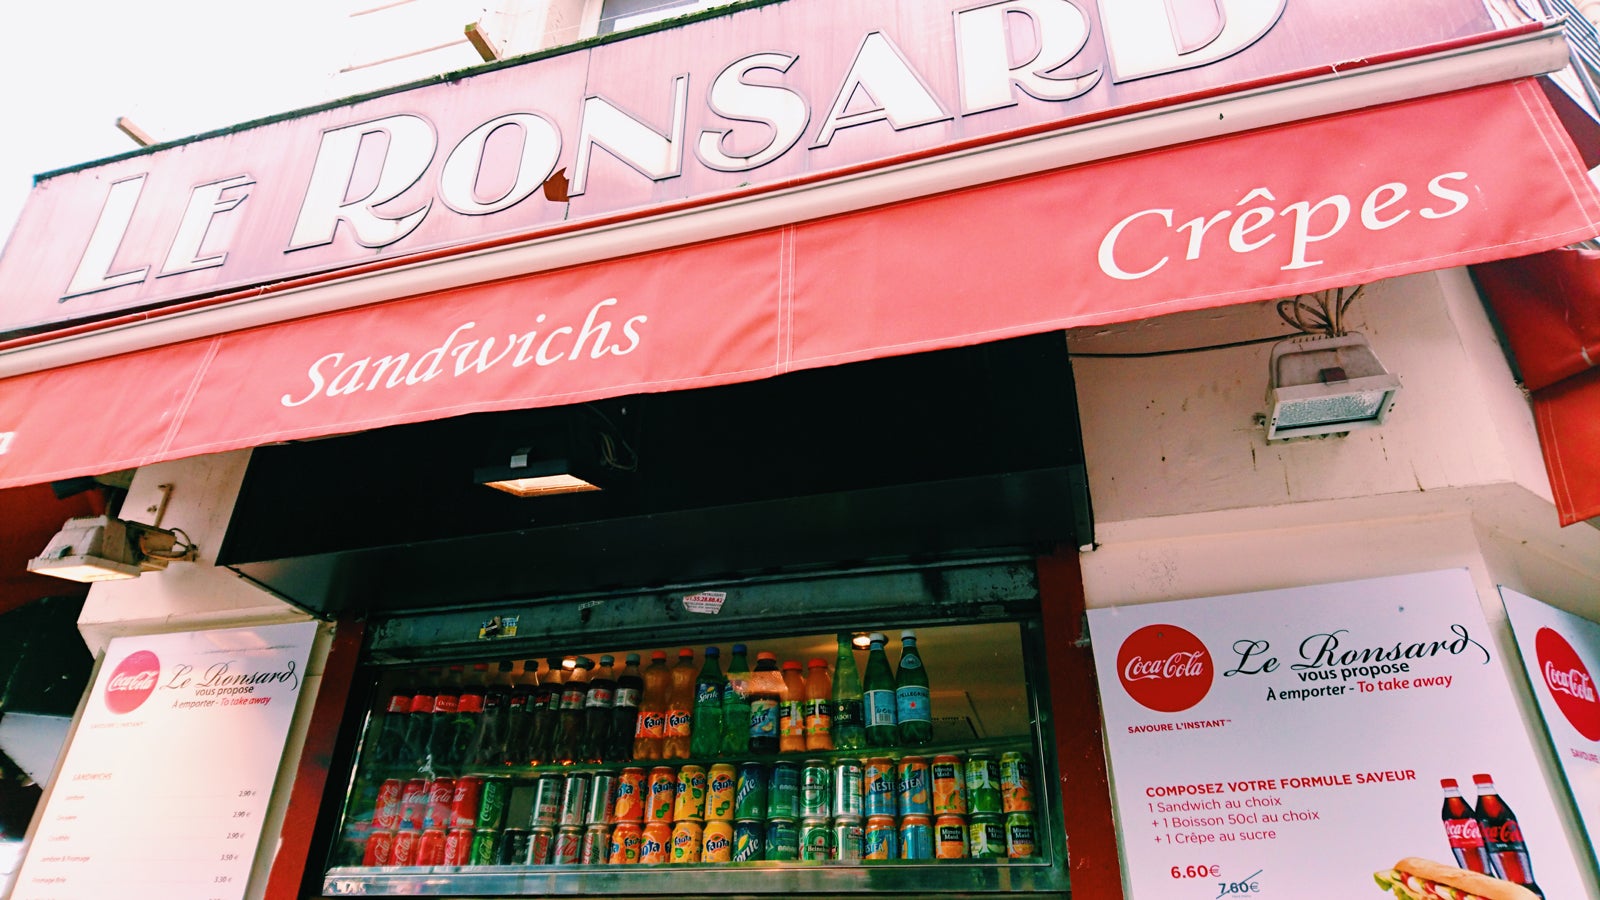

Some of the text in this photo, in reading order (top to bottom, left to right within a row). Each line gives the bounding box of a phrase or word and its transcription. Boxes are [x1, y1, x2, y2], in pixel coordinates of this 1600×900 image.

[59, 0, 1286, 303] LE RONSARD
[1097, 171, 1470, 280] Crêpes
[281, 297, 648, 408] Sandwichs
[1223, 623, 1491, 678] Le Ronsard
[159, 660, 299, 692] Le Ronsard
[1124, 651, 1205, 682] Coca-Cola
[1298, 661, 1410, 682] vous propose
[107, 671, 159, 692] Coca-Cola
[195, 686, 254, 701] vous propose
[1266, 687, 1277, 702] À
[1279, 684, 1346, 701] emporter
[1357, 680, 1375, 693] To
[1378, 678, 1410, 692] take
[1413, 675, 1453, 689] away
[1545, 660, 1596, 703] Coca-Cola
[179, 698, 215, 710] emporter
[220, 698, 230, 707] To
[230, 697, 247, 707] take
[248, 696, 272, 707] away
[1128, 722, 1174, 734] SAVOURE
[1146, 769, 1417, 798] COMPOSEZ VOTRE FORMULE SAVEUR
[1148, 795, 1282, 813] 1 Sandwich au choix
[1151, 809, 1320, 829] + 1 Boisson 50cl au choix
[1154, 829, 1276, 845] + 1 Crêpe au sucre
[1170, 864, 1222, 880] 6.60€
